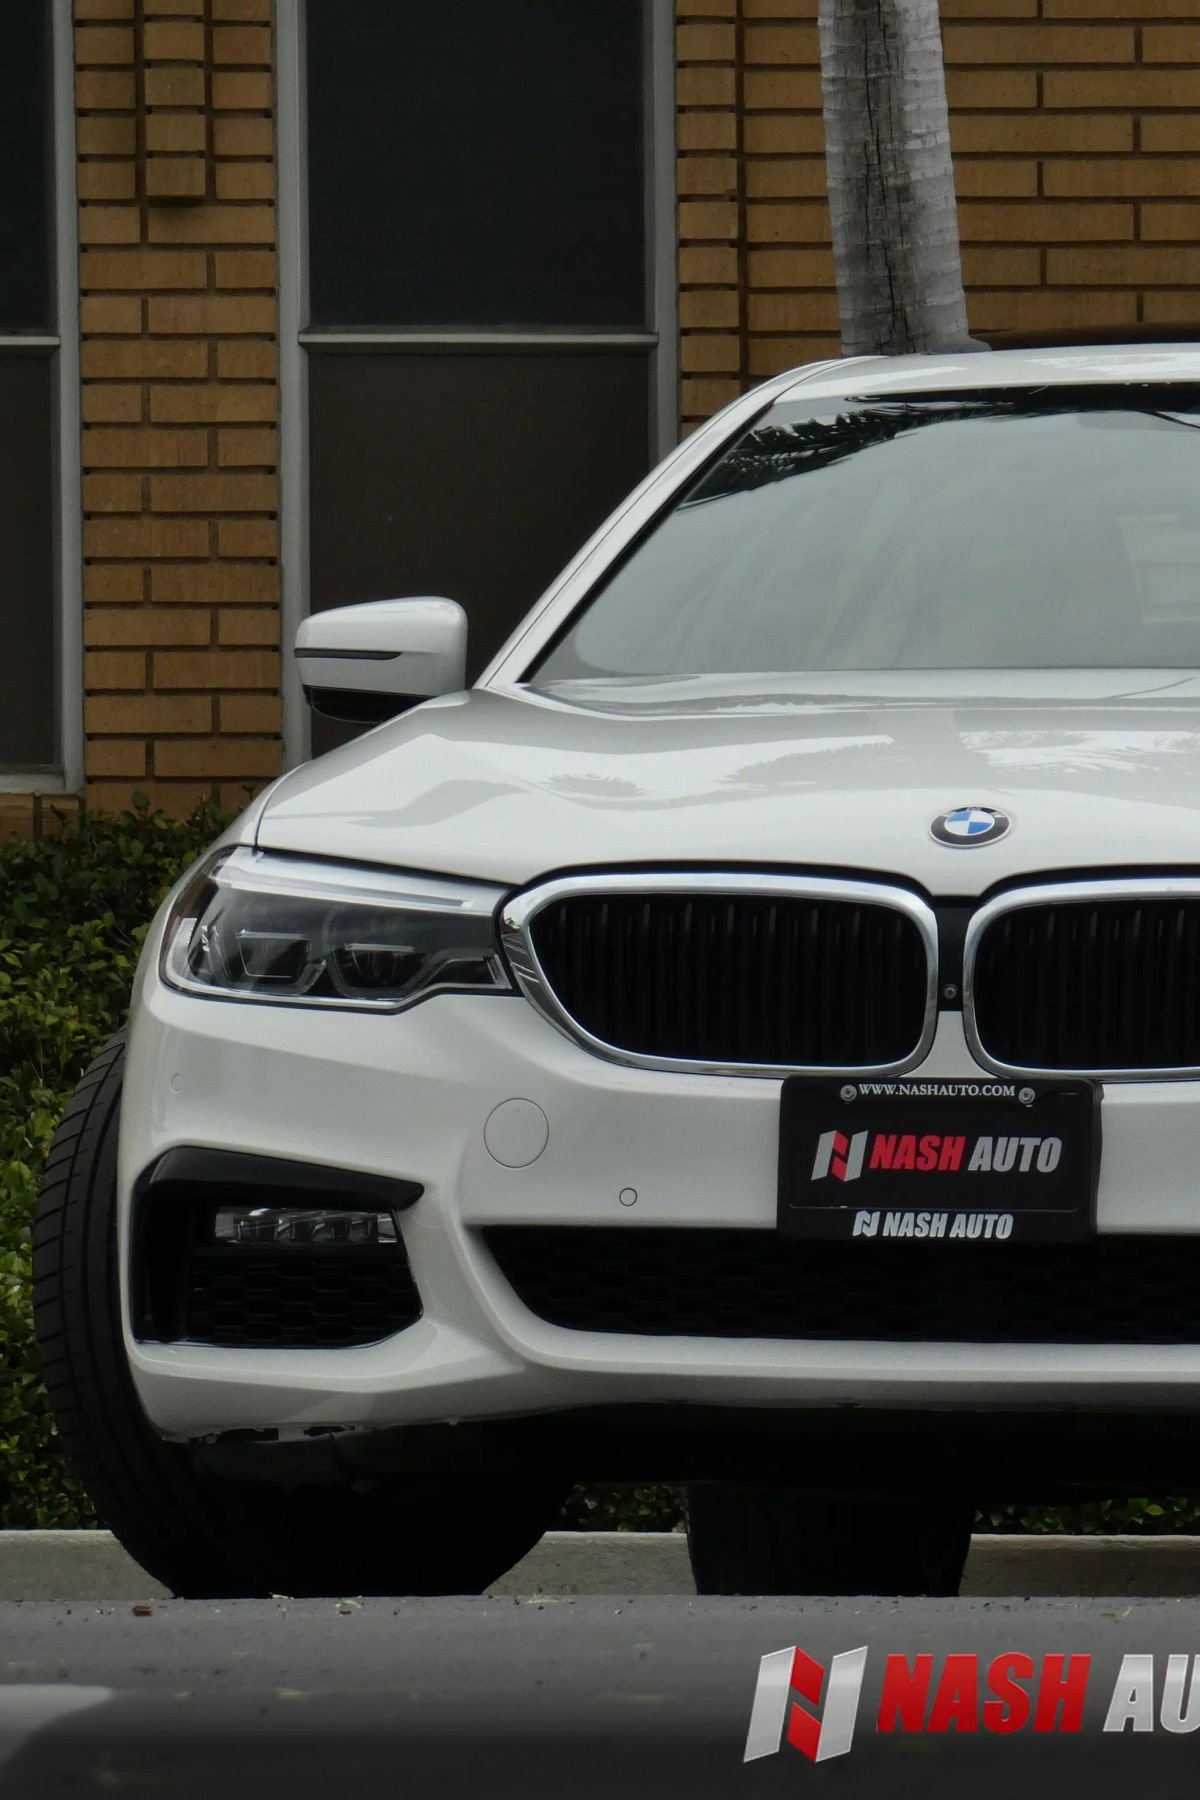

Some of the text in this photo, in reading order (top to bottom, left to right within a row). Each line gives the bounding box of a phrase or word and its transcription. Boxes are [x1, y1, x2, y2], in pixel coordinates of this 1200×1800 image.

[859, 1083, 1016, 1097] WWW.NASHAUTO.COM
[869, 1134, 966, 1171] NASH
[967, 1136, 1063, 1173] AUTO
[882, 1211, 948, 1238] NASH
[949, 1213, 1014, 1239] AUTO
